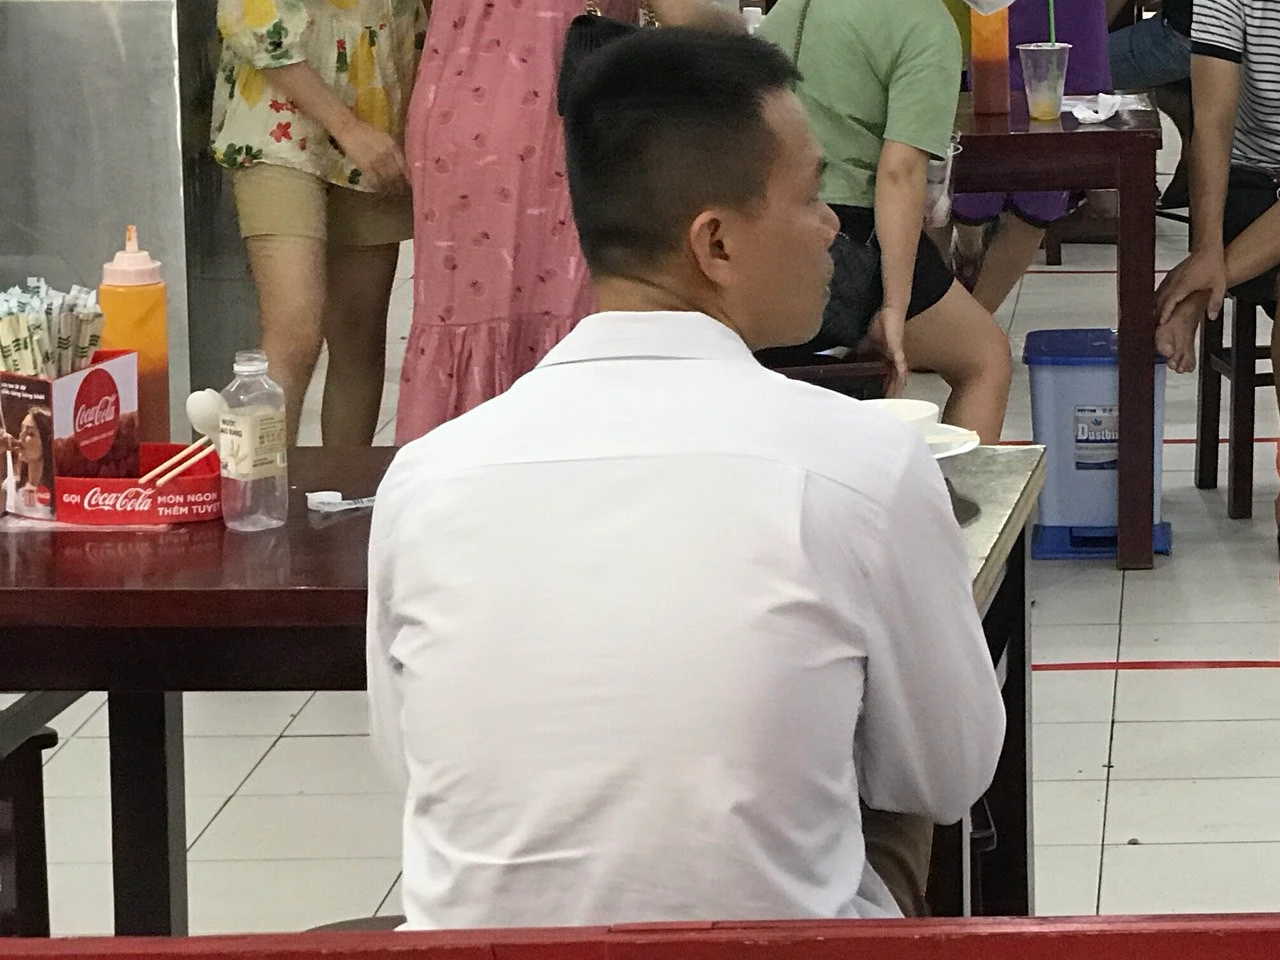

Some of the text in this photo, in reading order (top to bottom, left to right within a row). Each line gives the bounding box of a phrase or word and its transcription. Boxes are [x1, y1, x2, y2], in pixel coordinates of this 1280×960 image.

[76, 394, 116, 432] Coca-Cola
[63, 493, 81, 504] GỌI
[84, 486, 156, 511] Coca-Cola
[187, 492, 218, 503] NGON
[158, 505, 188, 516] THÊM
